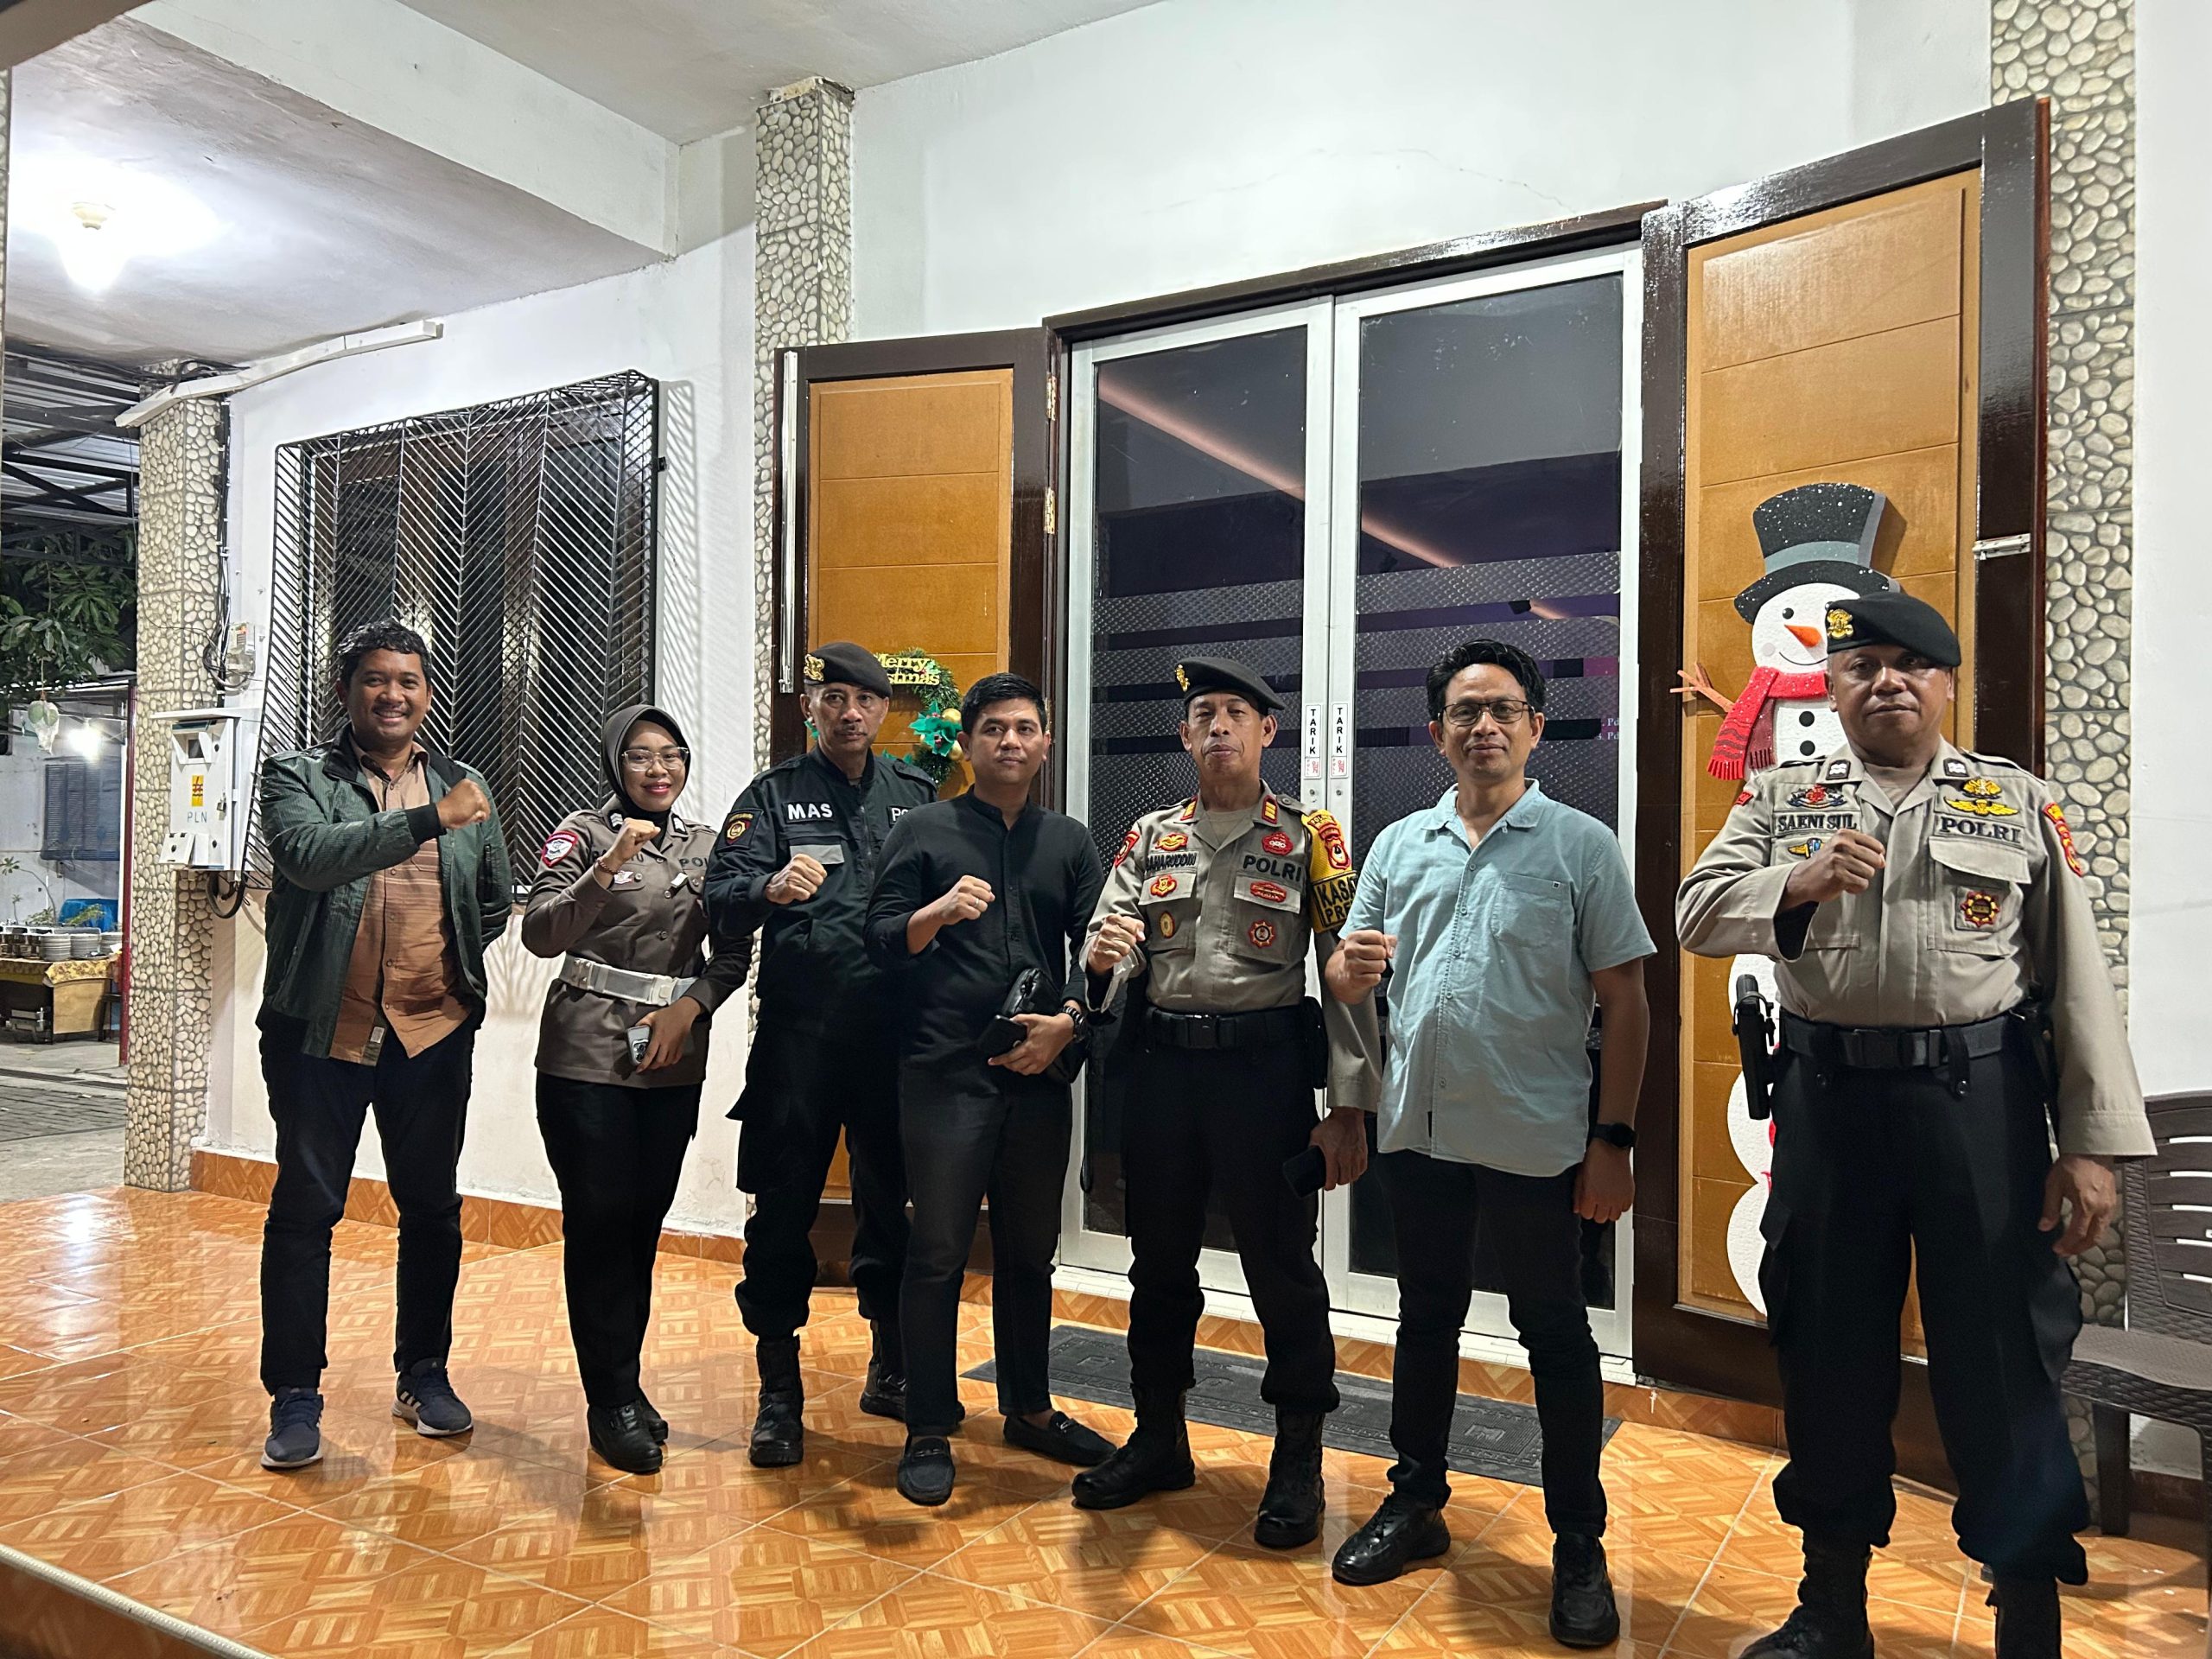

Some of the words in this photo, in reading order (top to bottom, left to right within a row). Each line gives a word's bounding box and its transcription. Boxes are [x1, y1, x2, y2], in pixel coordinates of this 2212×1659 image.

[187, 811, 207, 823] PLN
[787, 803, 834, 820] MAS
[1940, 816, 2021, 844] POLRI
[1243, 855, 1302, 882] POLRI
